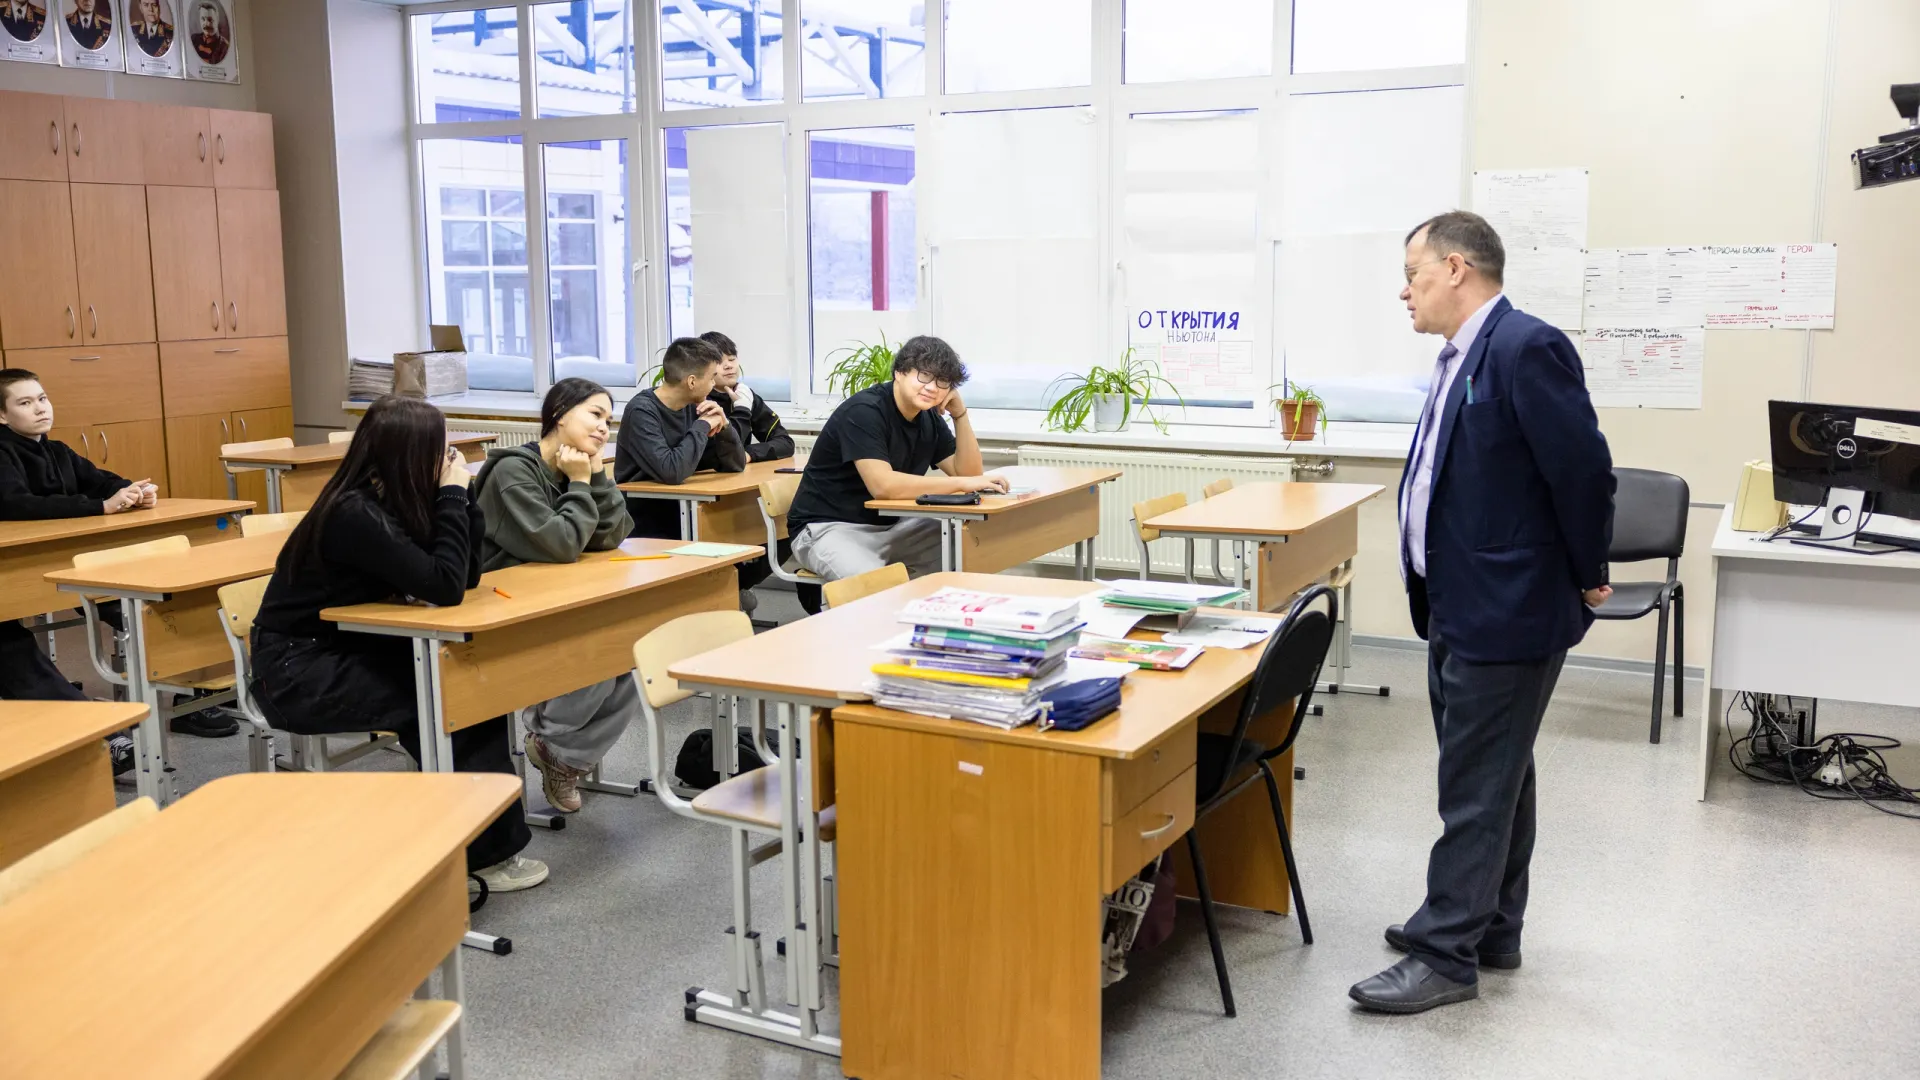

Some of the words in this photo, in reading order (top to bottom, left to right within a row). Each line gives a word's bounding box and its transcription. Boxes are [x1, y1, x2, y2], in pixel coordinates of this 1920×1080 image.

[1787, 245, 1812, 253] ГЕРОИ
[1138, 310, 1239, 330] ОТКРЫТИЯ
[1167, 330, 1216, 343] НЬЮТОНА
